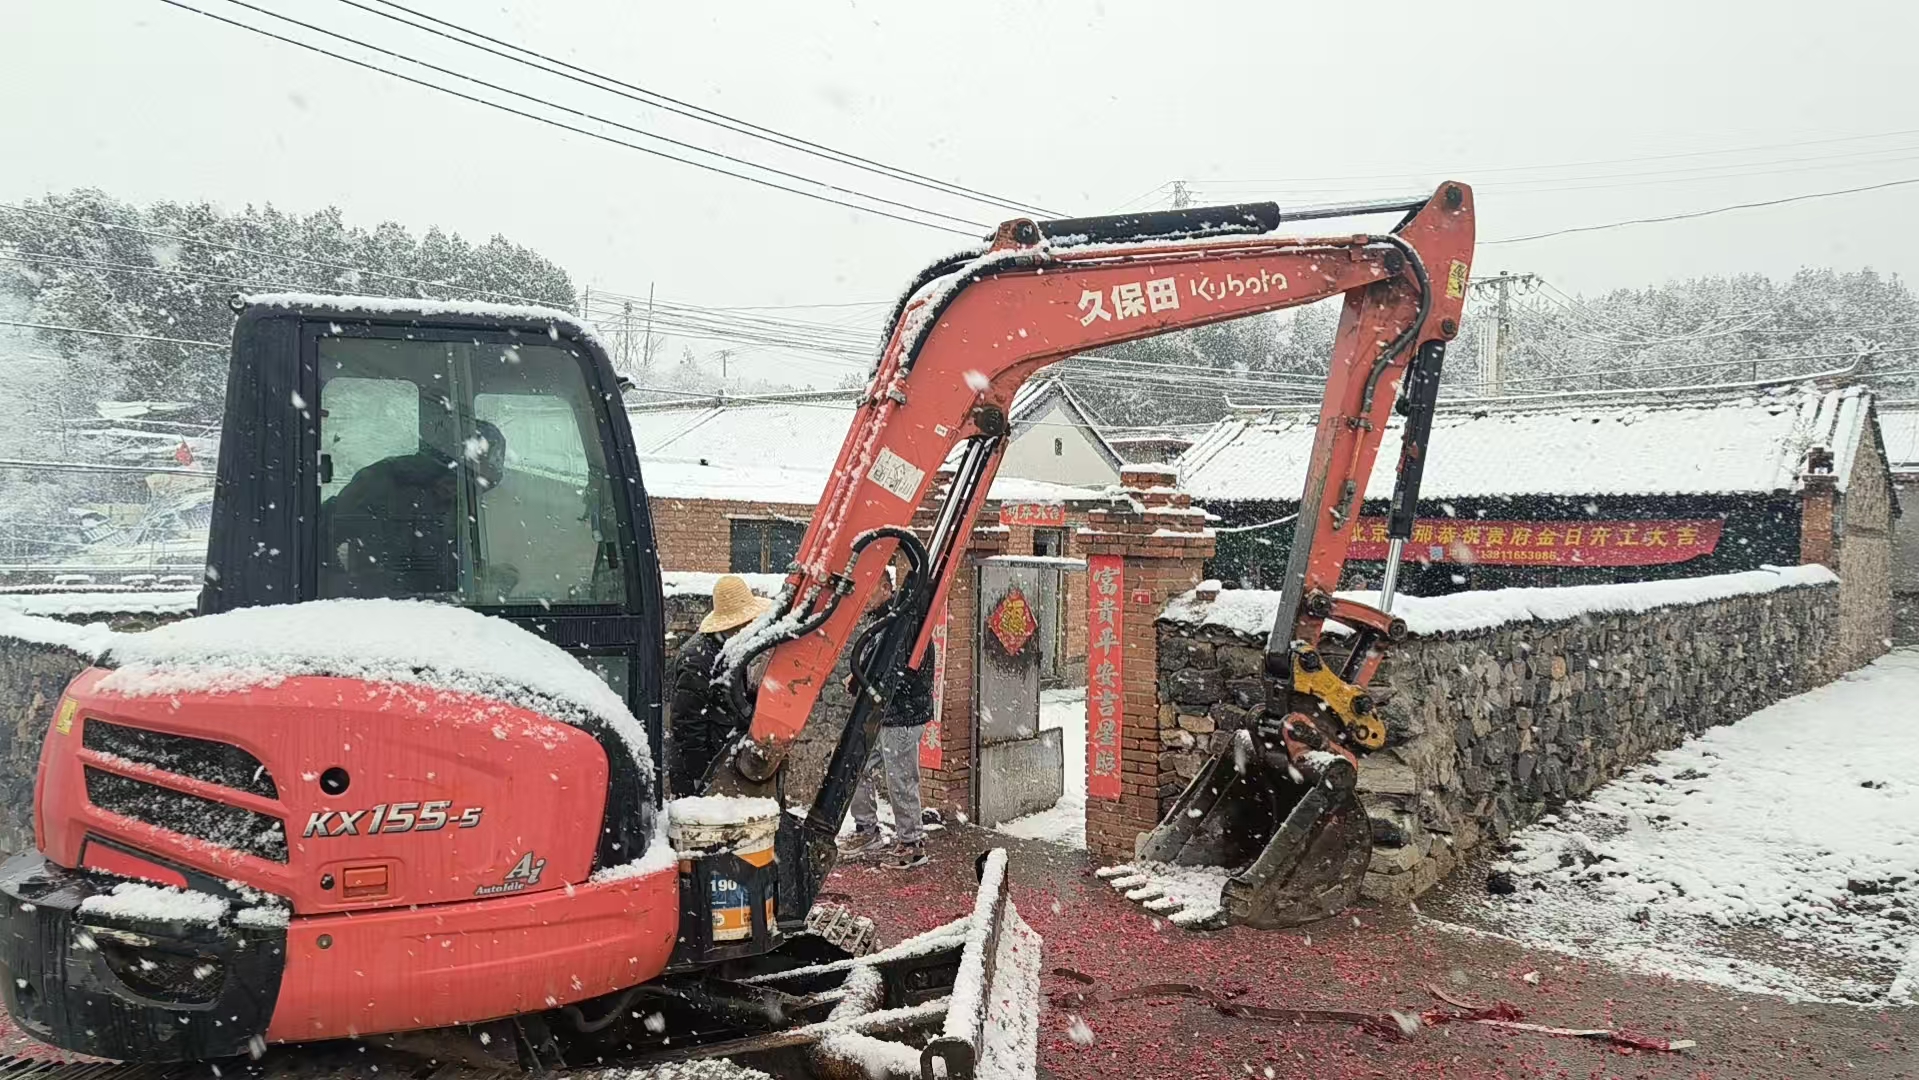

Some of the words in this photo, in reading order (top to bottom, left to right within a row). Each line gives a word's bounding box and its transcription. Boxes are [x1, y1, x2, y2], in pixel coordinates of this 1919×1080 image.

[1078, 277, 1179, 327] 久保田
[1190, 269, 1289, 301] Kubota
[302, 799, 484, 838] KX155-5
[474, 882, 524, 896] AutoIdle
